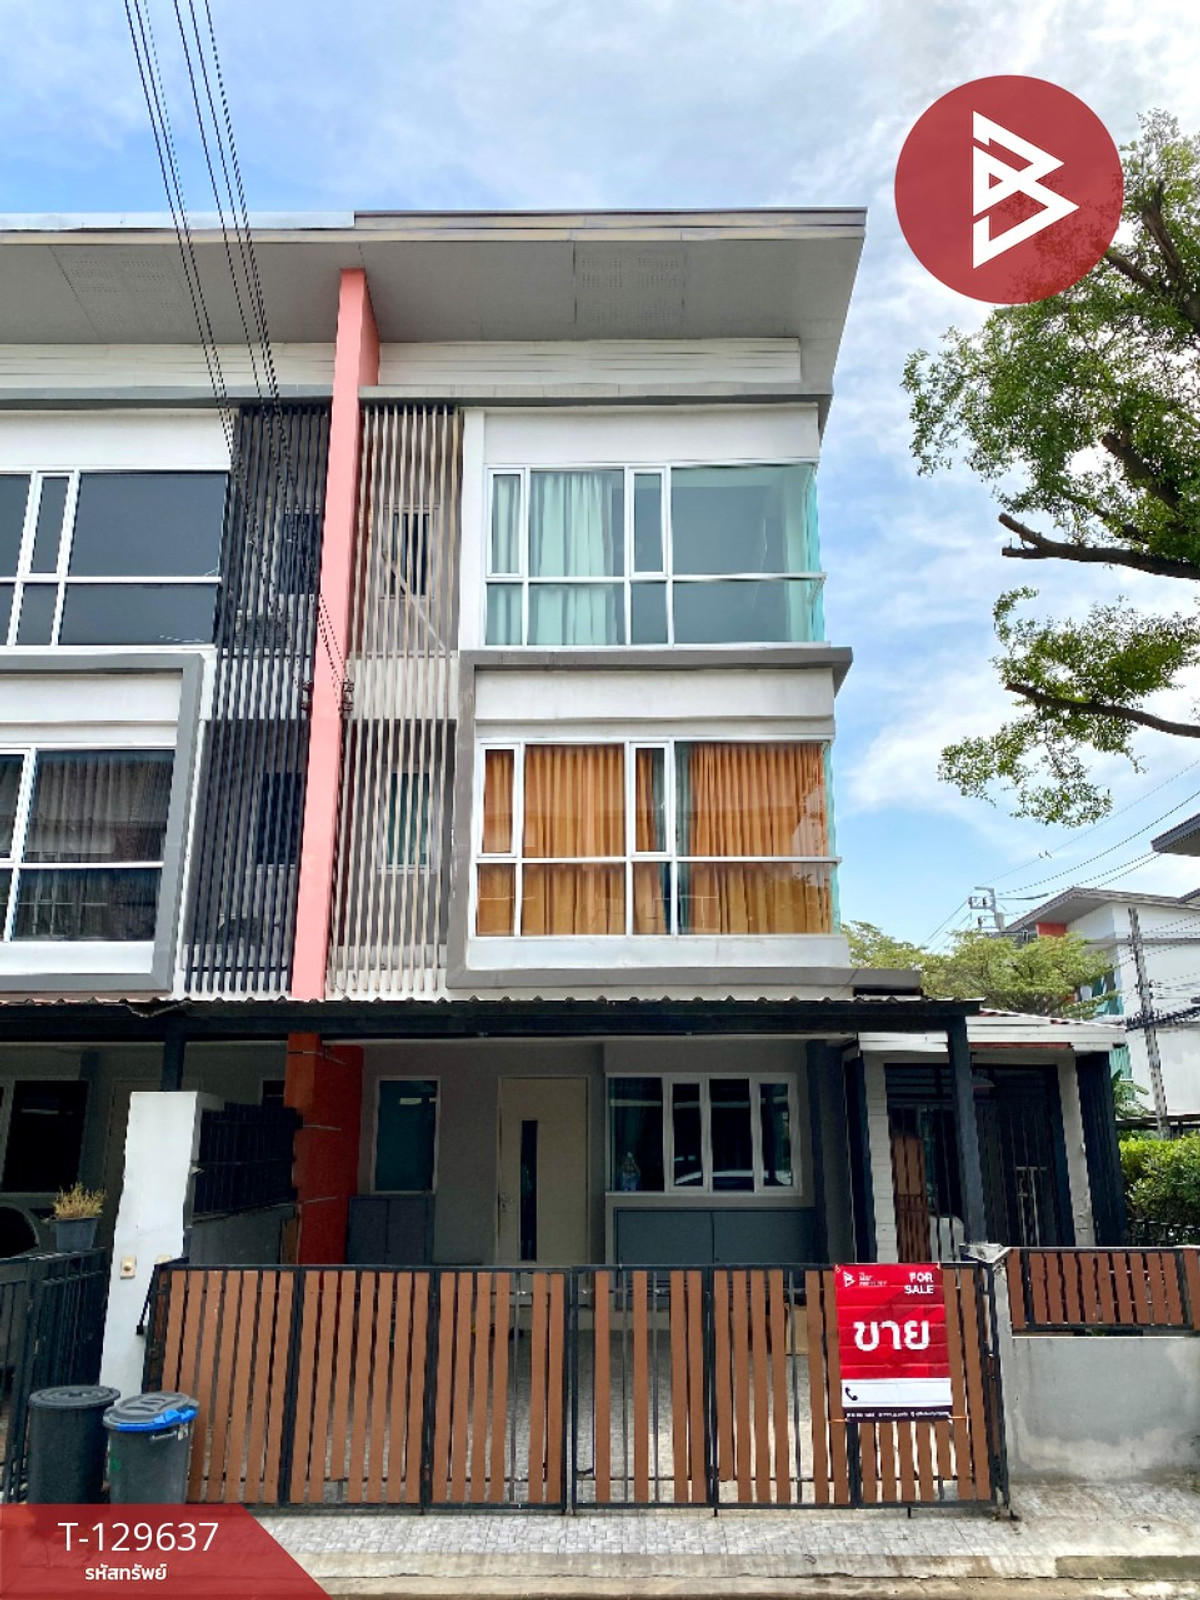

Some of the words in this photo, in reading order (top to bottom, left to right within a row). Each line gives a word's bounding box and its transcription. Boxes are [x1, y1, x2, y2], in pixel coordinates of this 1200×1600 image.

[909, 1272, 934, 1282] FOR
[904, 1285, 934, 1294] SALE
[853, 1320, 930, 1351] ขาย
